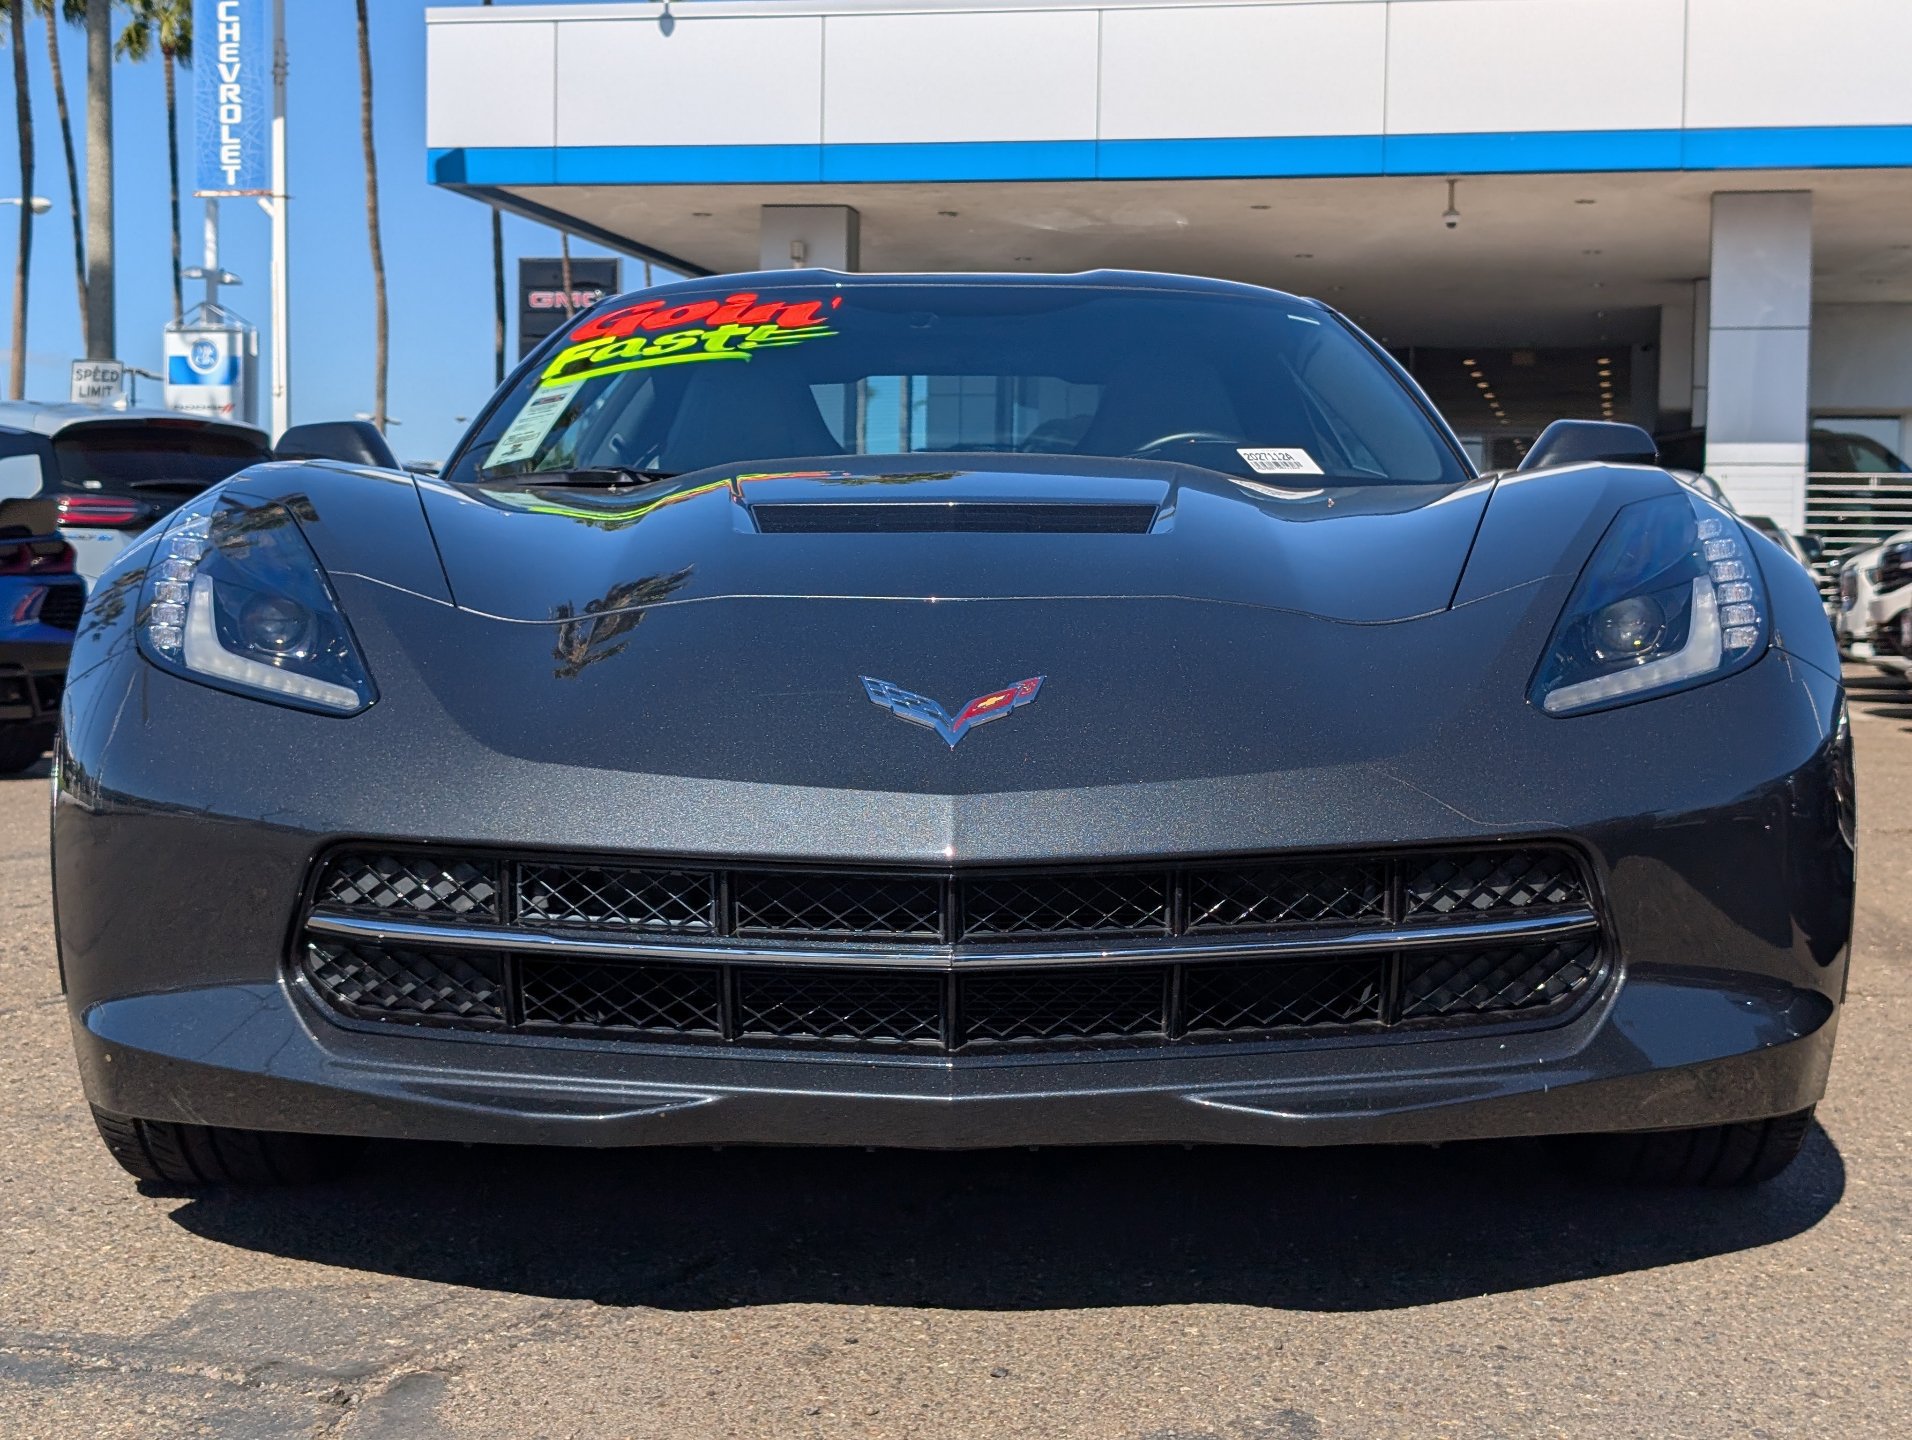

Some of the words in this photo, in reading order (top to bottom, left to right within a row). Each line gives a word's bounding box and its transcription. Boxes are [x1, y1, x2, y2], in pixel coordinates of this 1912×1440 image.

[217, 0, 242, 186] CHEVROLET
[528, 290, 599, 309] GMC
[570, 293, 842, 341] Goin'
[75, 368, 120, 382] SPEED
[79, 385, 114, 398] LIMIT
[1243, 452, 1295, 461] 2027112A
